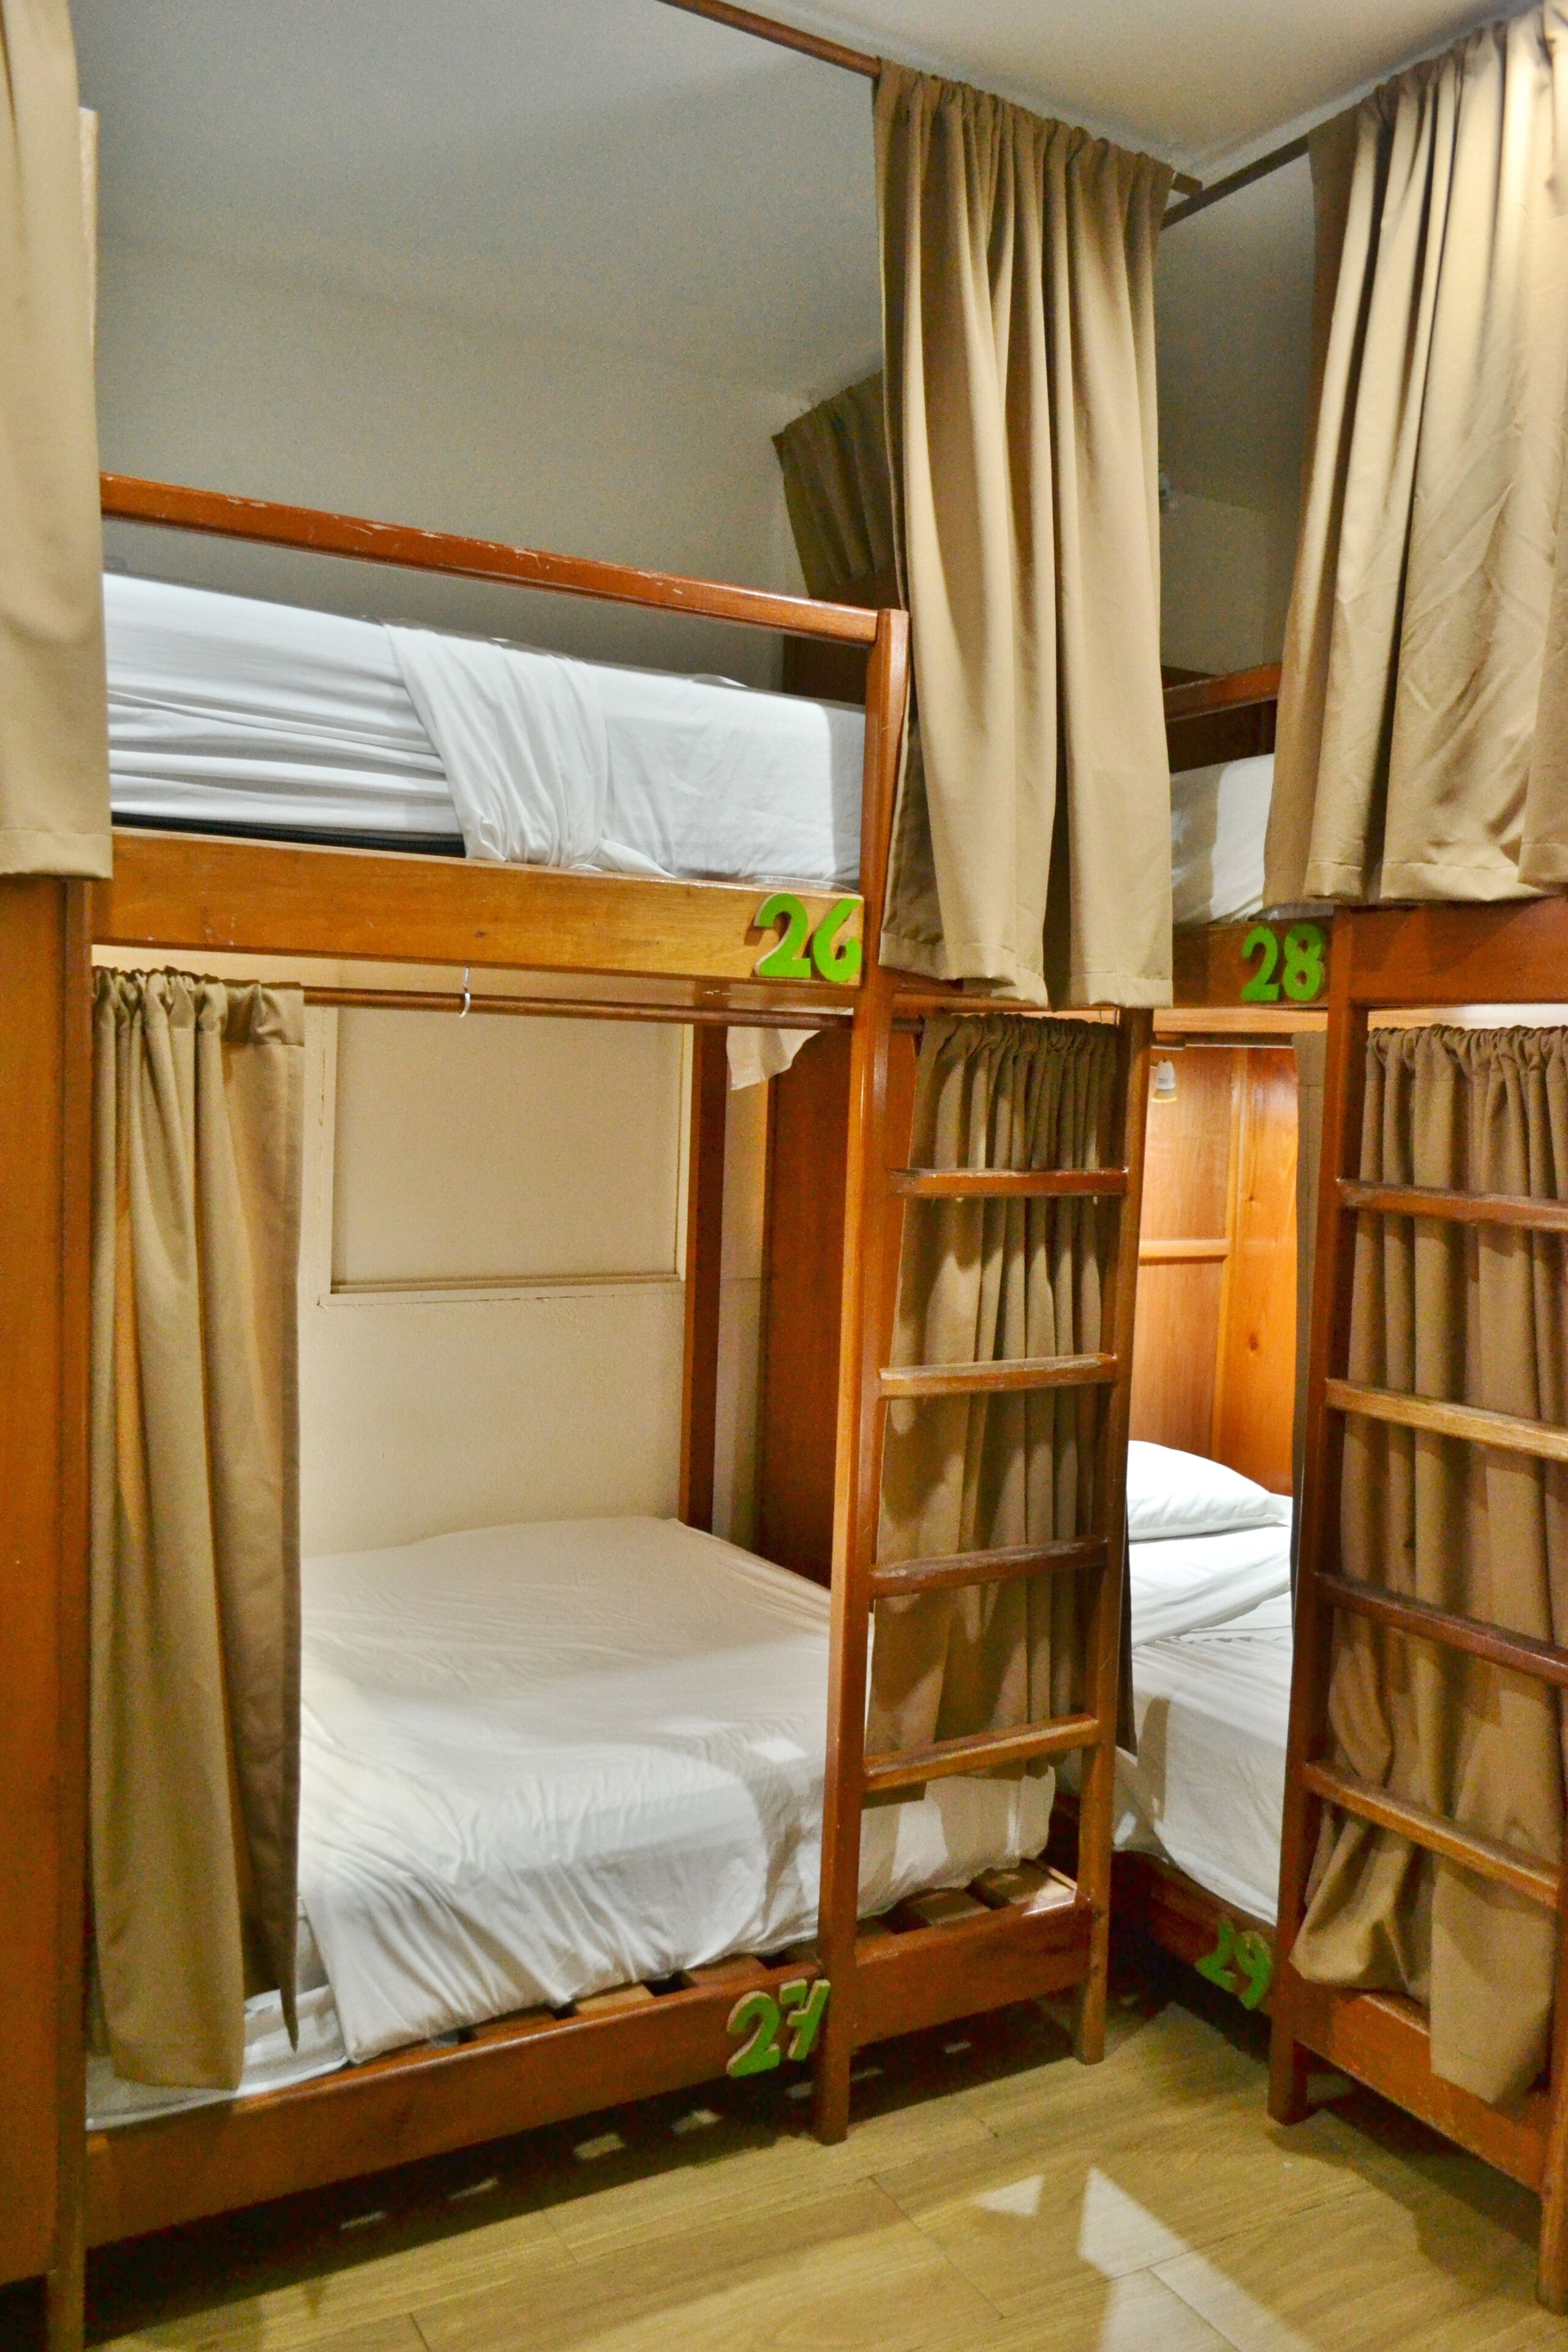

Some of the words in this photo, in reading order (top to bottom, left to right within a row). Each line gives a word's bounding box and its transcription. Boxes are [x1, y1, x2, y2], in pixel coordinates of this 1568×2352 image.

[754, 892, 862, 982] 26
[1240, 924, 1324, 1001] 28
[1195, 1917, 1272, 2010] 29
[726, 1978, 831, 2078] 27
